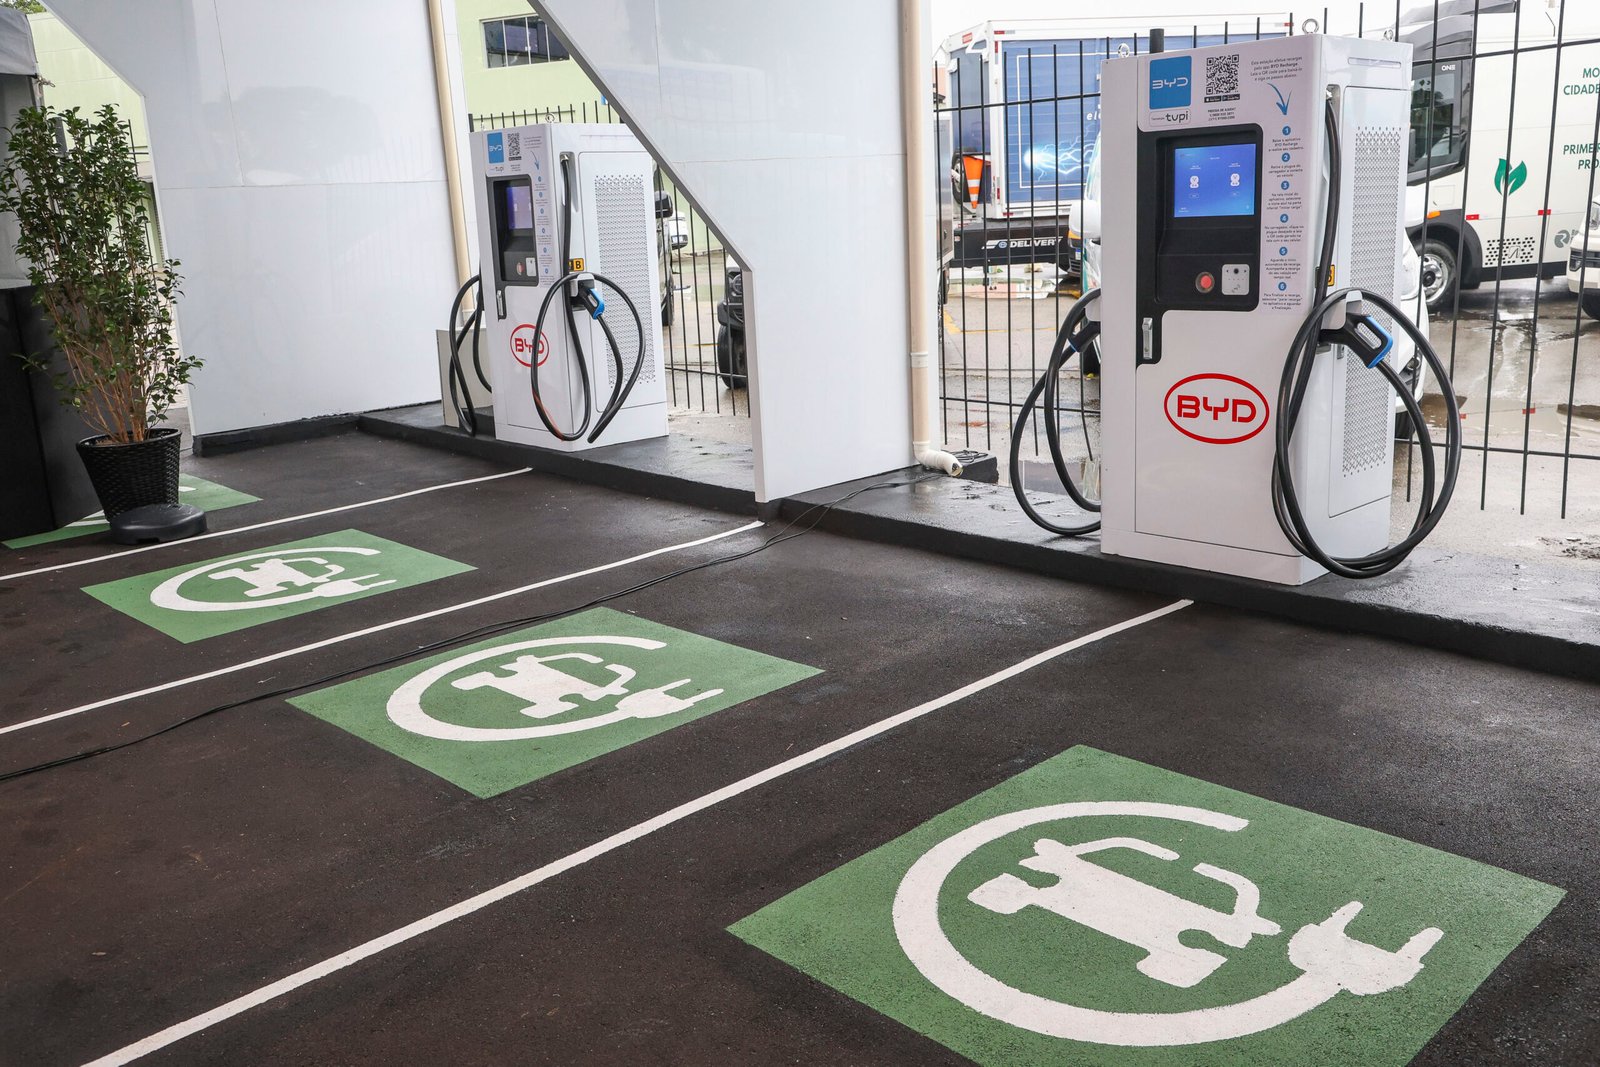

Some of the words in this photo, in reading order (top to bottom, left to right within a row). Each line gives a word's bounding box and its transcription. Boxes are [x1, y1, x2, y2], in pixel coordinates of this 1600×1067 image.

[1152, 77, 1188, 89] BYD
[1165, 110, 1188, 123] tupi
[1563, 143, 1600, 155] PRIMER
[576, 261, 581, 269] B
[1177, 395, 1256, 423] BYD
